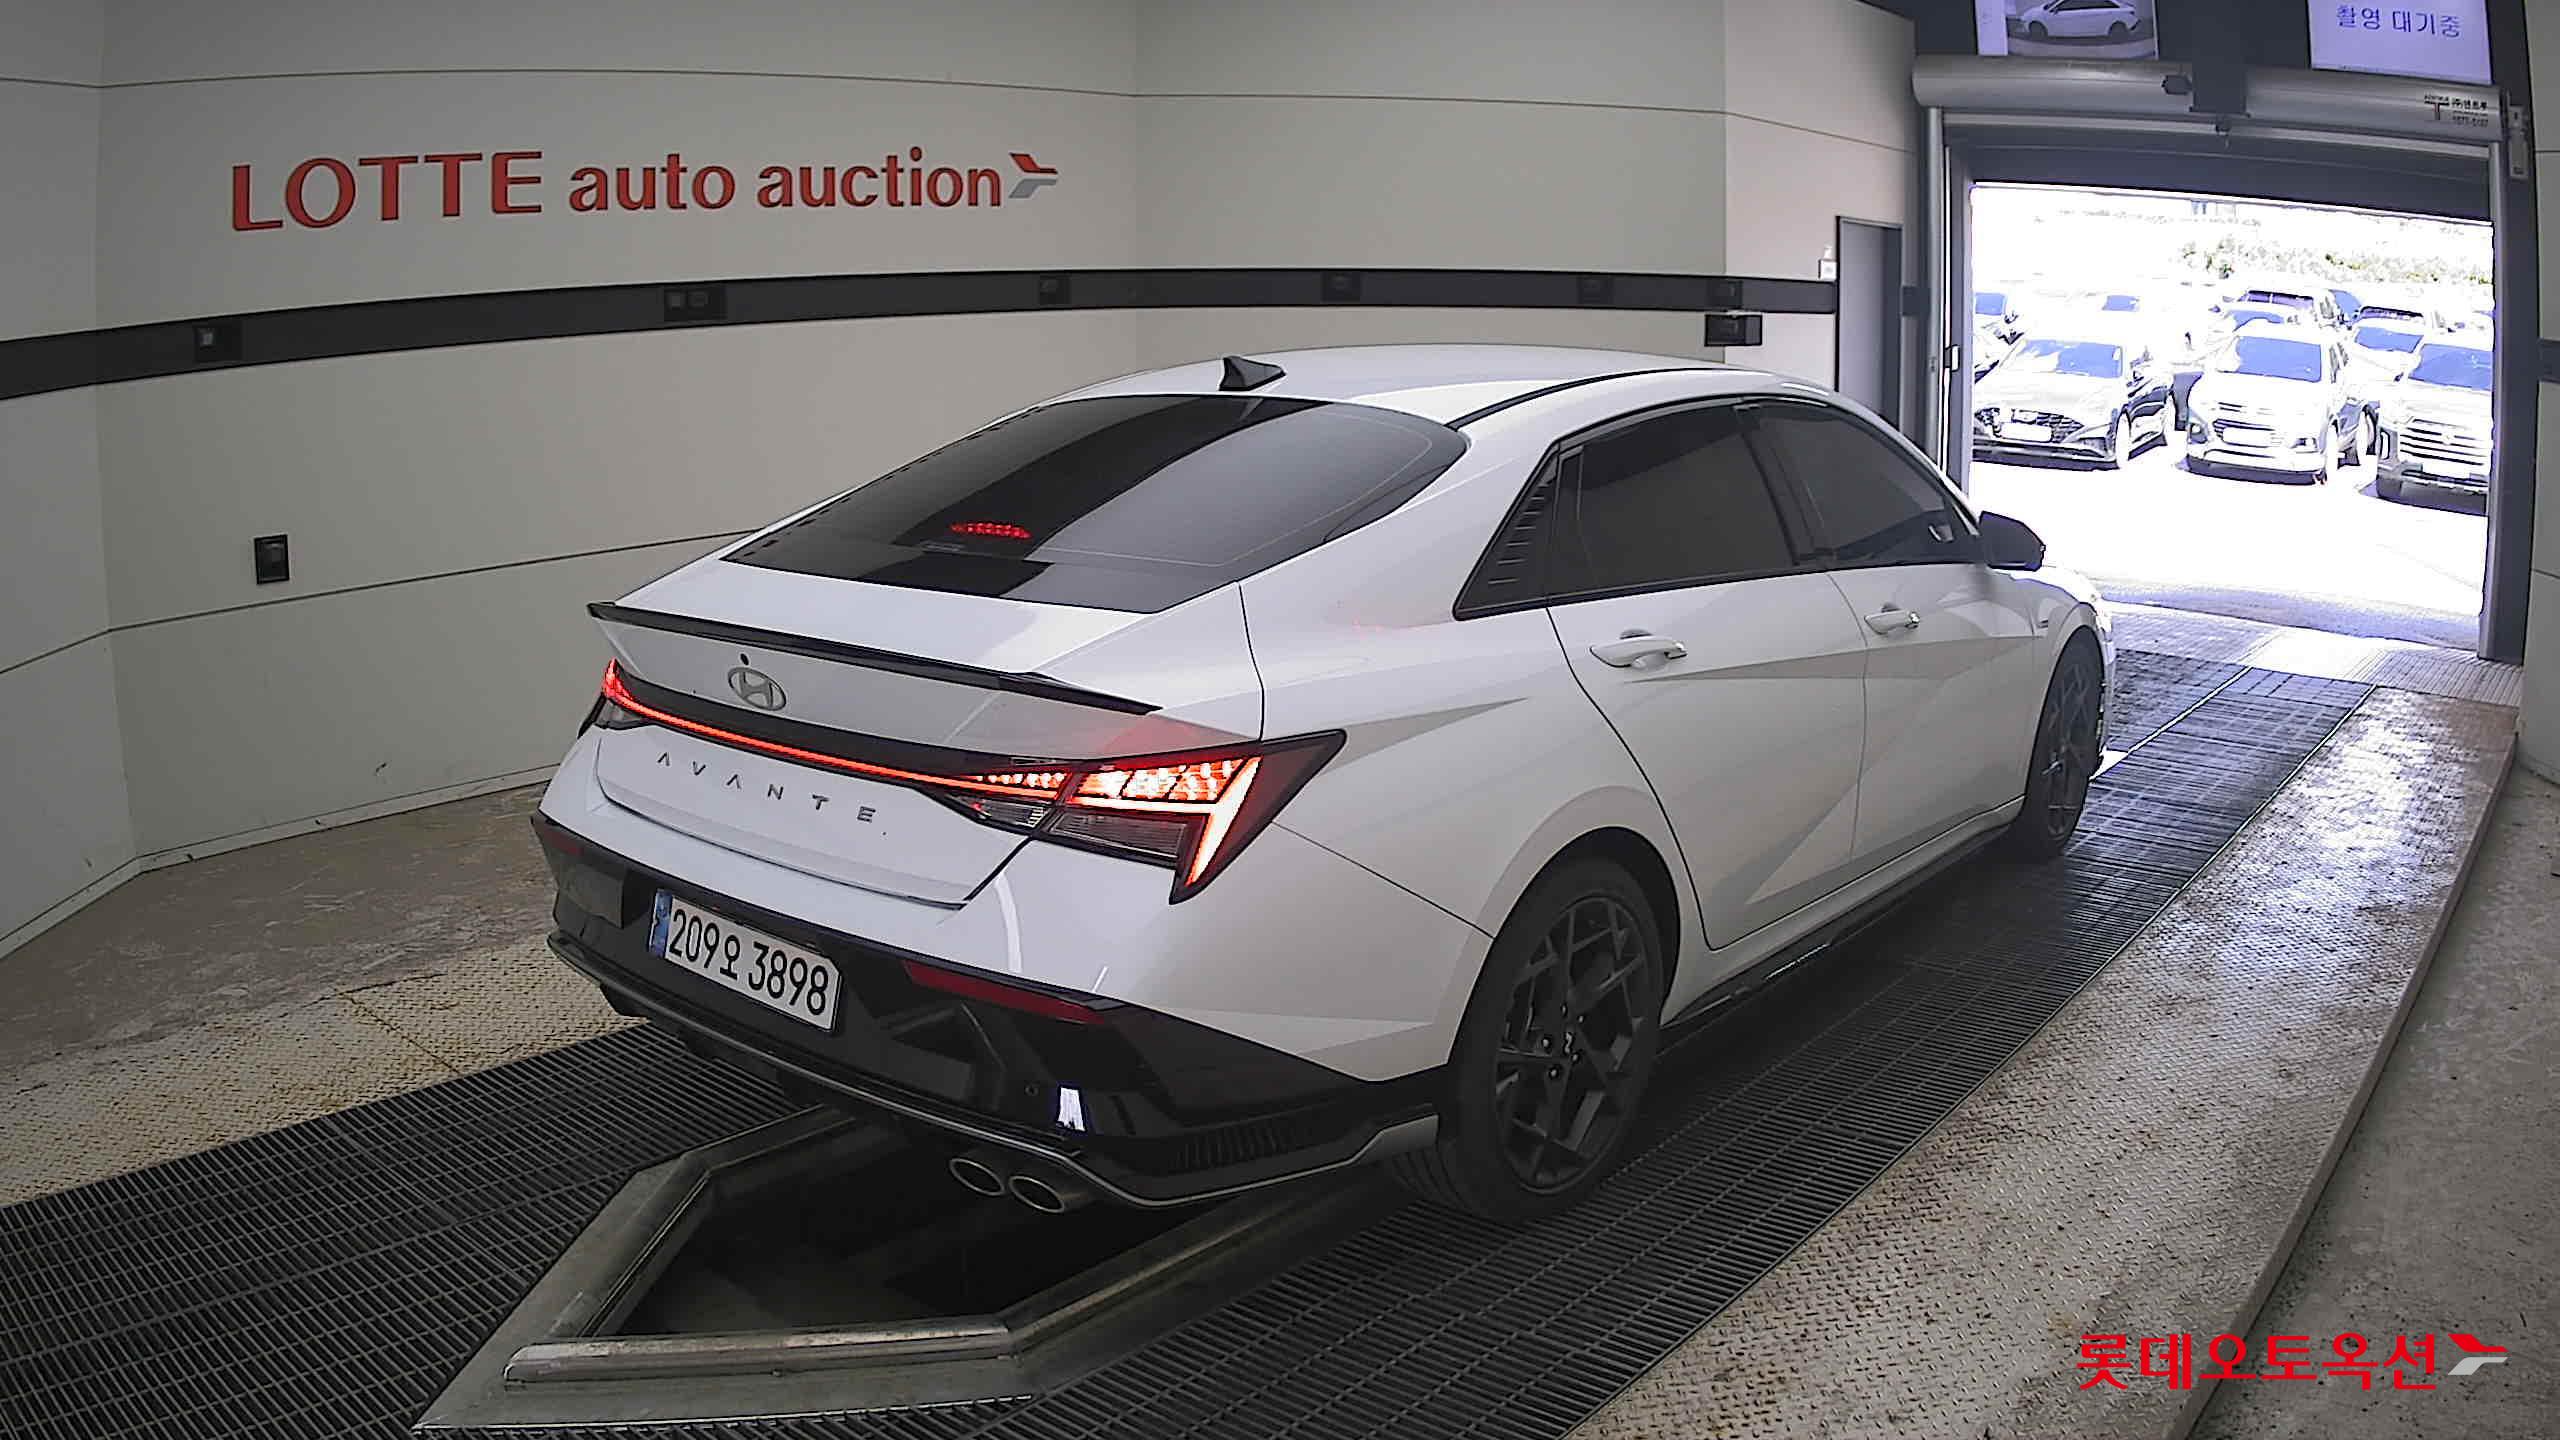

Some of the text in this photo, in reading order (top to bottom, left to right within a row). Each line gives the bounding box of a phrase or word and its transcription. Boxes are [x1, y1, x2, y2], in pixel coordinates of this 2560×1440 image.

[2337, 5, 2460, 38] 촬영 대기중
[231, 147, 1002, 231] LOTTE auto auction
[657, 752, 877, 822] AVANTE
[669, 908, 830, 1017] 209오 3898
